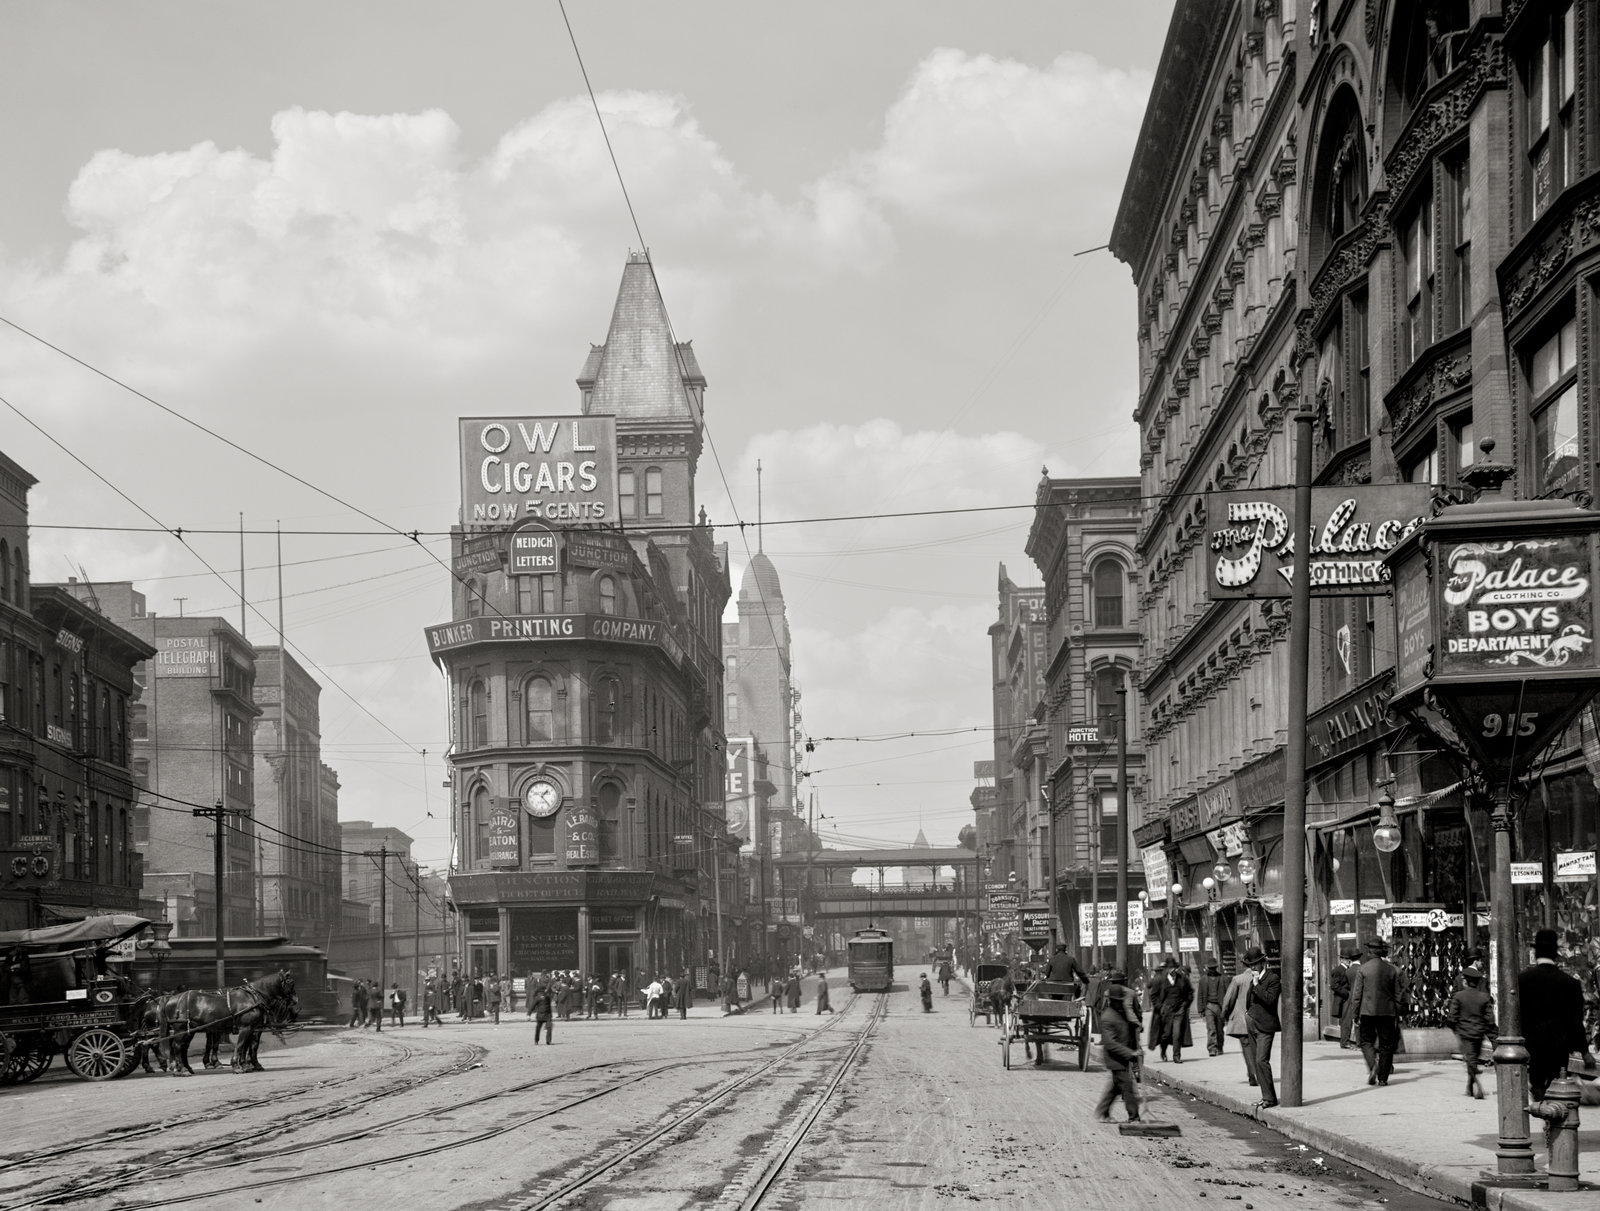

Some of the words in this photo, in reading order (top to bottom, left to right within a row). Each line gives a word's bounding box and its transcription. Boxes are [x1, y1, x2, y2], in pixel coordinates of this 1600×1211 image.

[481, 422, 597, 454] OWL
[481, 455, 597, 493] CIGARS
[474, 503, 519, 520] NOW
[526, 499, 544, 517] 5
[546, 501, 606, 520] CENTS
[517, 537, 553, 548] NEIDICH
[1211, 526, 1256, 550] The
[457, 549, 497, 569] JUNCTION
[517, 555, 554, 567] LETTERS
[571, 545, 628, 564] JUNCTION
[1308, 565, 1374, 583] OTHING
[1444, 557, 1582, 605] Palace
[1446, 575, 1469, 587] The
[1493, 591, 1543, 601] CLOTHING
[1546, 590, 1564, 600] CO.
[1467, 606, 1560, 633] BOYS
[56, 629, 83, 653] SIGNS
[432, 623, 475, 648] BUNKER
[490, 618, 574, 638] PRINTING
[167, 638, 206, 648] POSTAL
[1404, 628, 1425, 658] BOYS
[1448, 634, 1552, 653] DEPARTMENT
[158, 650, 217, 664] TELEGRAPH
[167, 666, 208, 675] BUILDING
[1482, 711, 1540, 738] 915
[47, 724, 73, 747] SIGNS
[1069, 732, 1099, 742] HOTEL
[725, 772, 743, 793] E
[572, 832, 581, 841] &
[566, 850, 580, 860] REAL
[501, 875, 581, 885] JUNCTION
[499, 889, 539, 898] TICKET
[1084, 911, 1110, 920] SUDAY
[513, 934, 576, 942] JUNCTION
[12, 1016, 40, 1024] WELLS
[46, 1013, 71, 1021] FARGO
[72, 1011, 80, 1019] &
[79, 1010, 113, 1019] COMPANY
